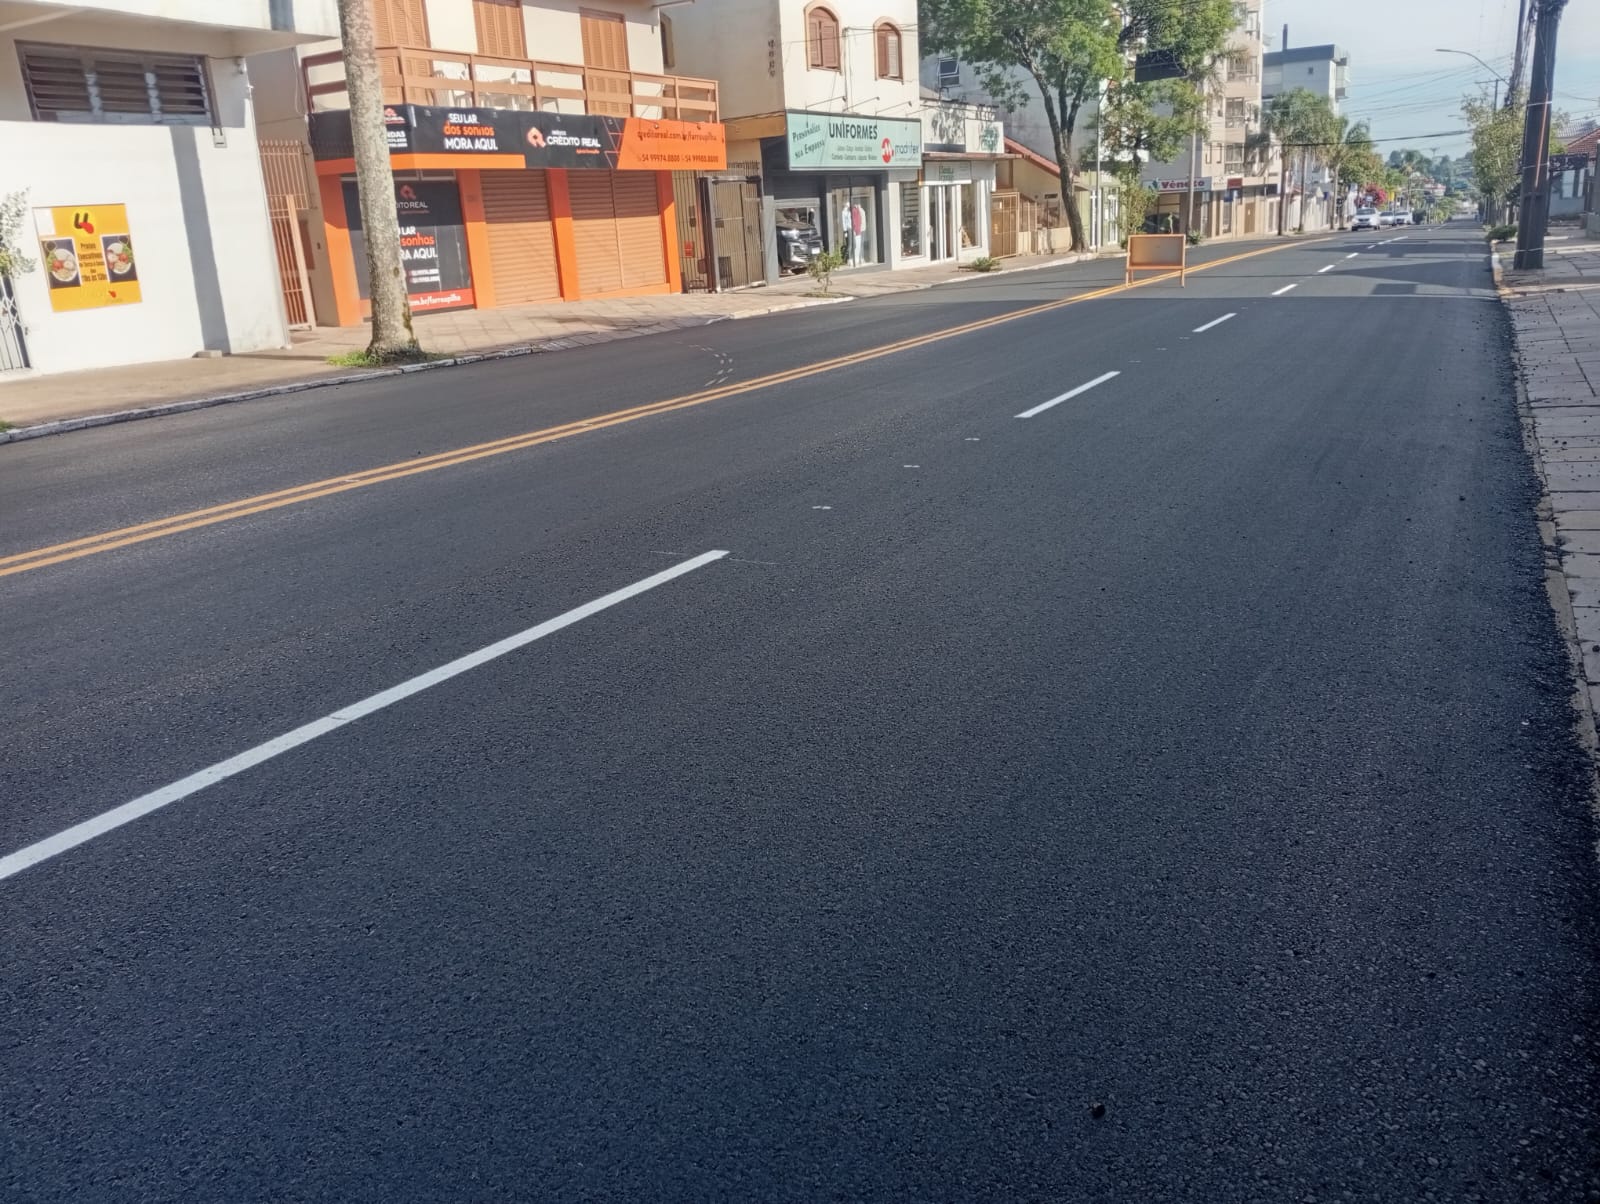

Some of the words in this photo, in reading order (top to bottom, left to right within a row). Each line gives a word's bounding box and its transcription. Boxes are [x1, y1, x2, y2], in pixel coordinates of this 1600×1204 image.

[448, 113, 463, 124] SEU
[828, 122, 878, 140] UNIFORMES
[444, 137, 474, 150] MORA
[580, 137, 601, 148] REAL
[401, 232, 435, 247] sonhos
